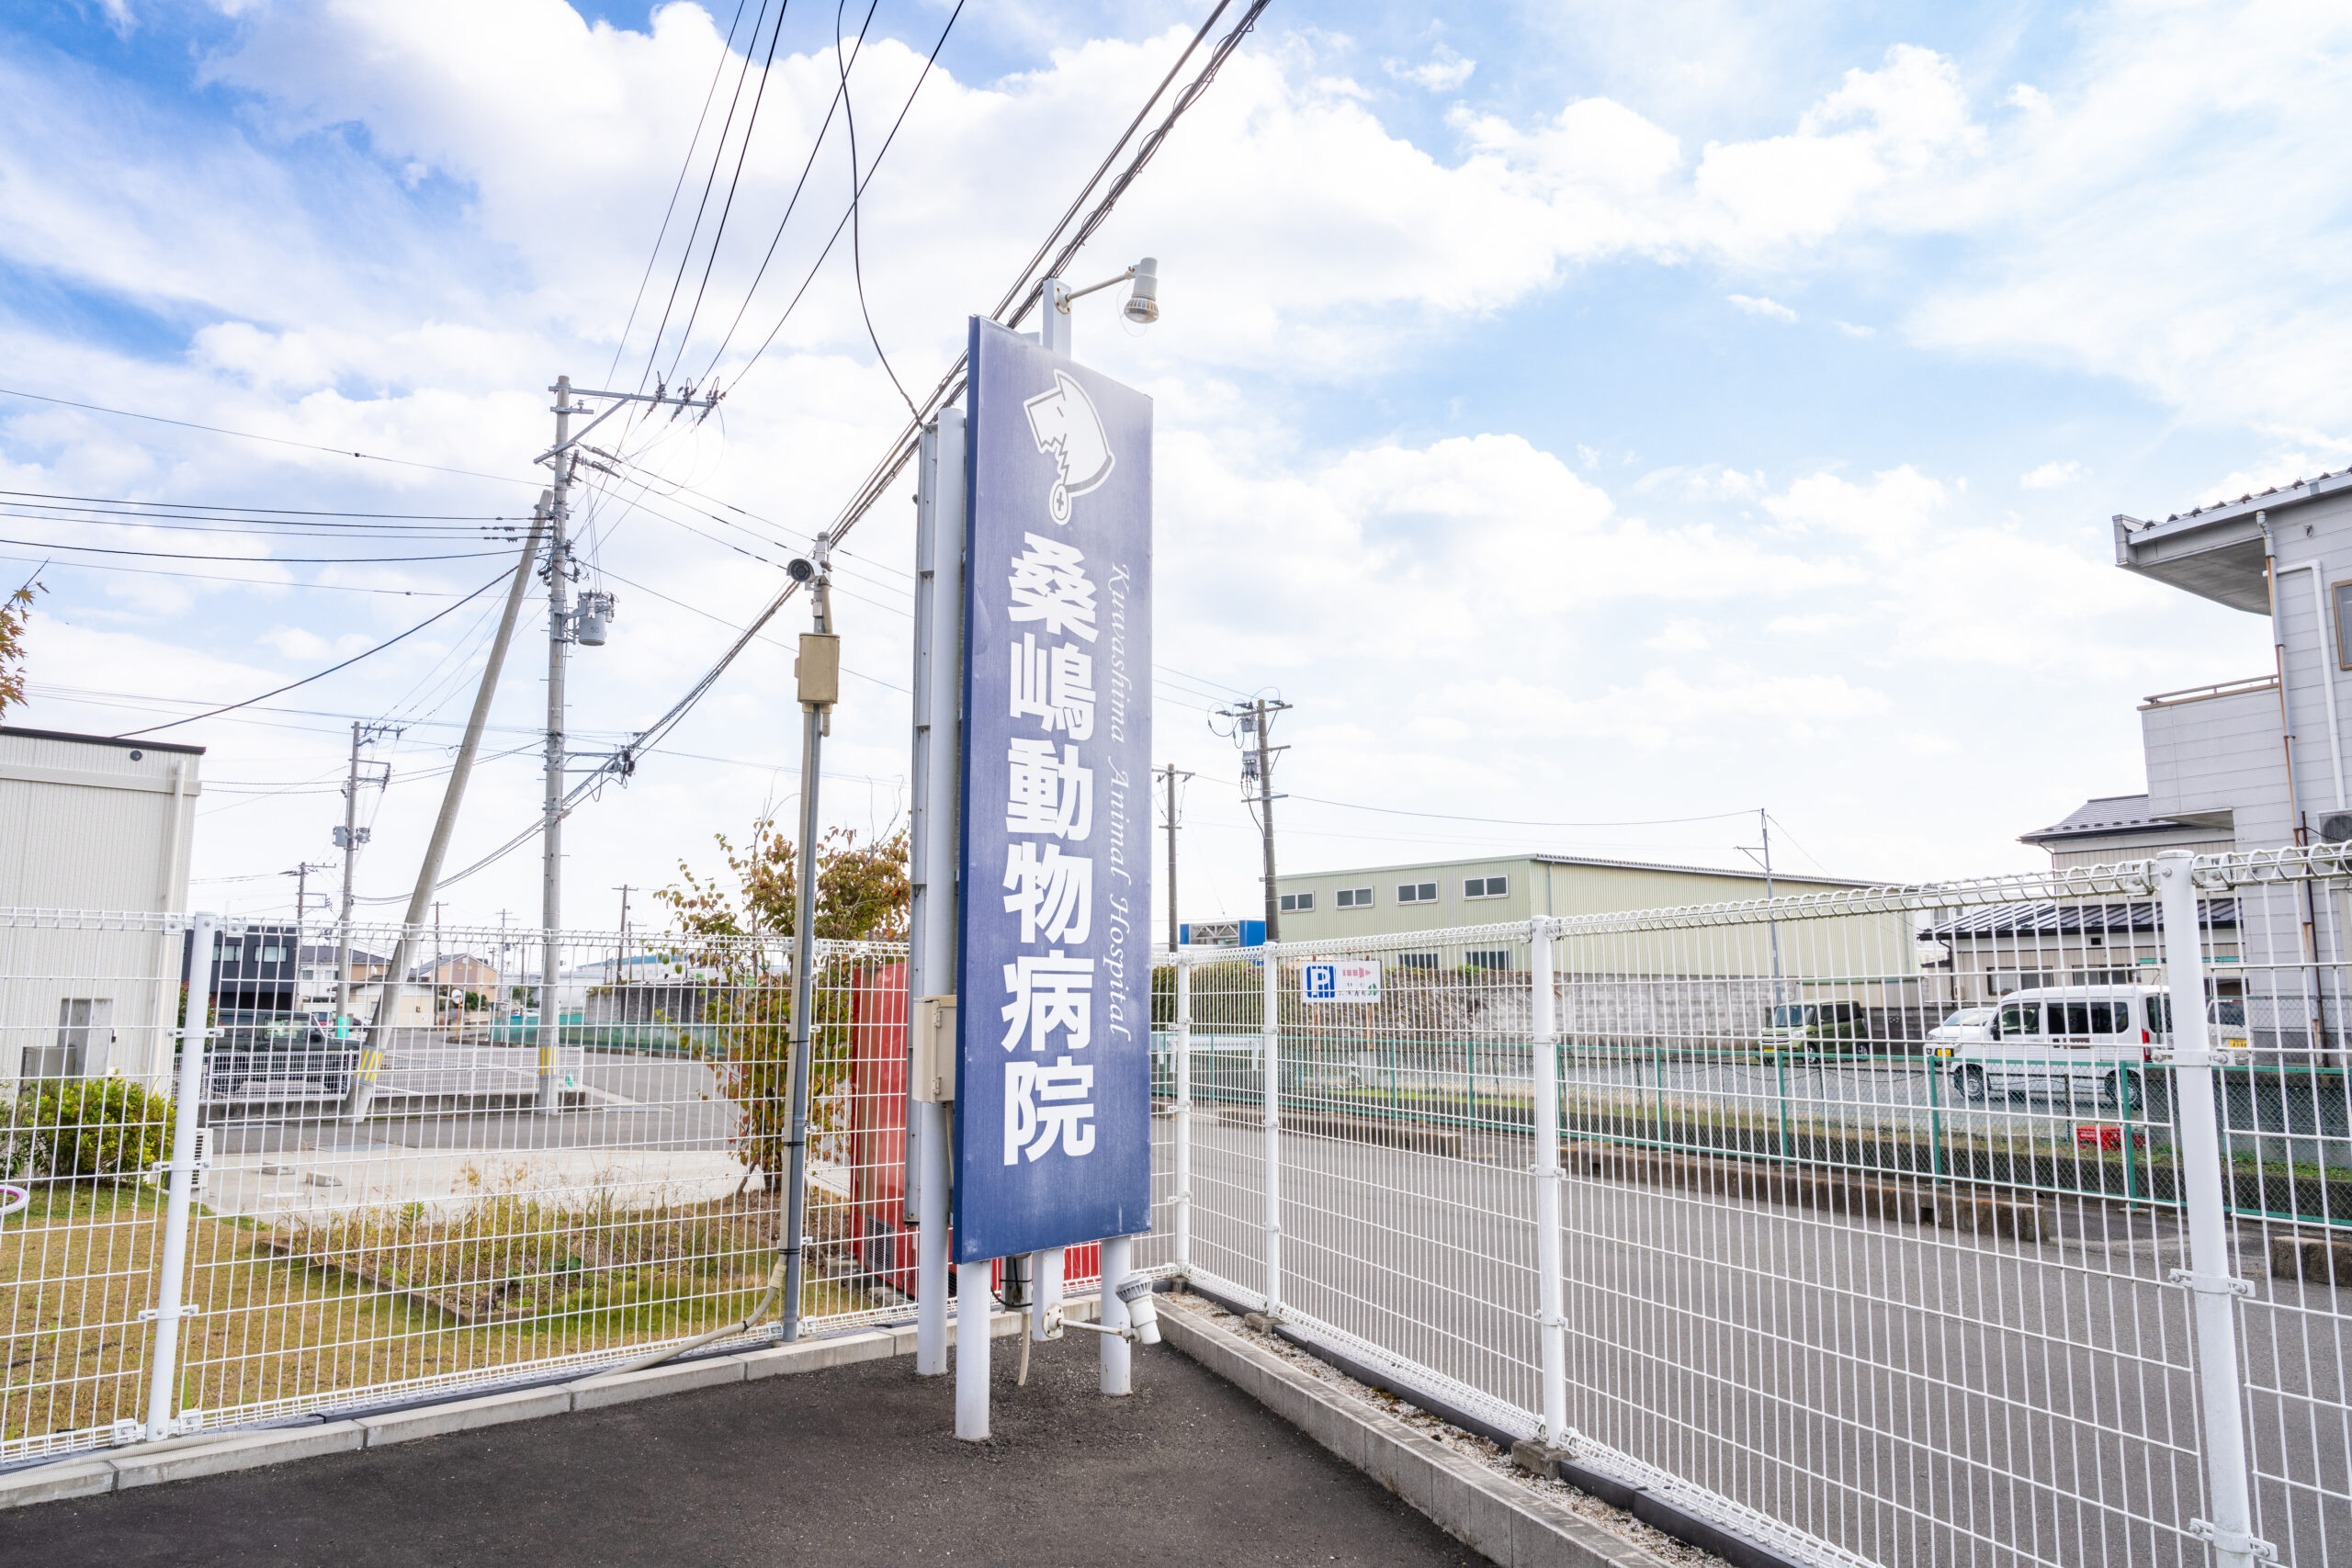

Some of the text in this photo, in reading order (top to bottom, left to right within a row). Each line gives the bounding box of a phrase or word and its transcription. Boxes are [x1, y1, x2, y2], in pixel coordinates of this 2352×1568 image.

[1001, 531, 1100, 1166] 桑嶋動物病院
[1102, 561, 1132, 1042] Kuwashima Animal Hospital
[1312, 968, 1330, 996] P
